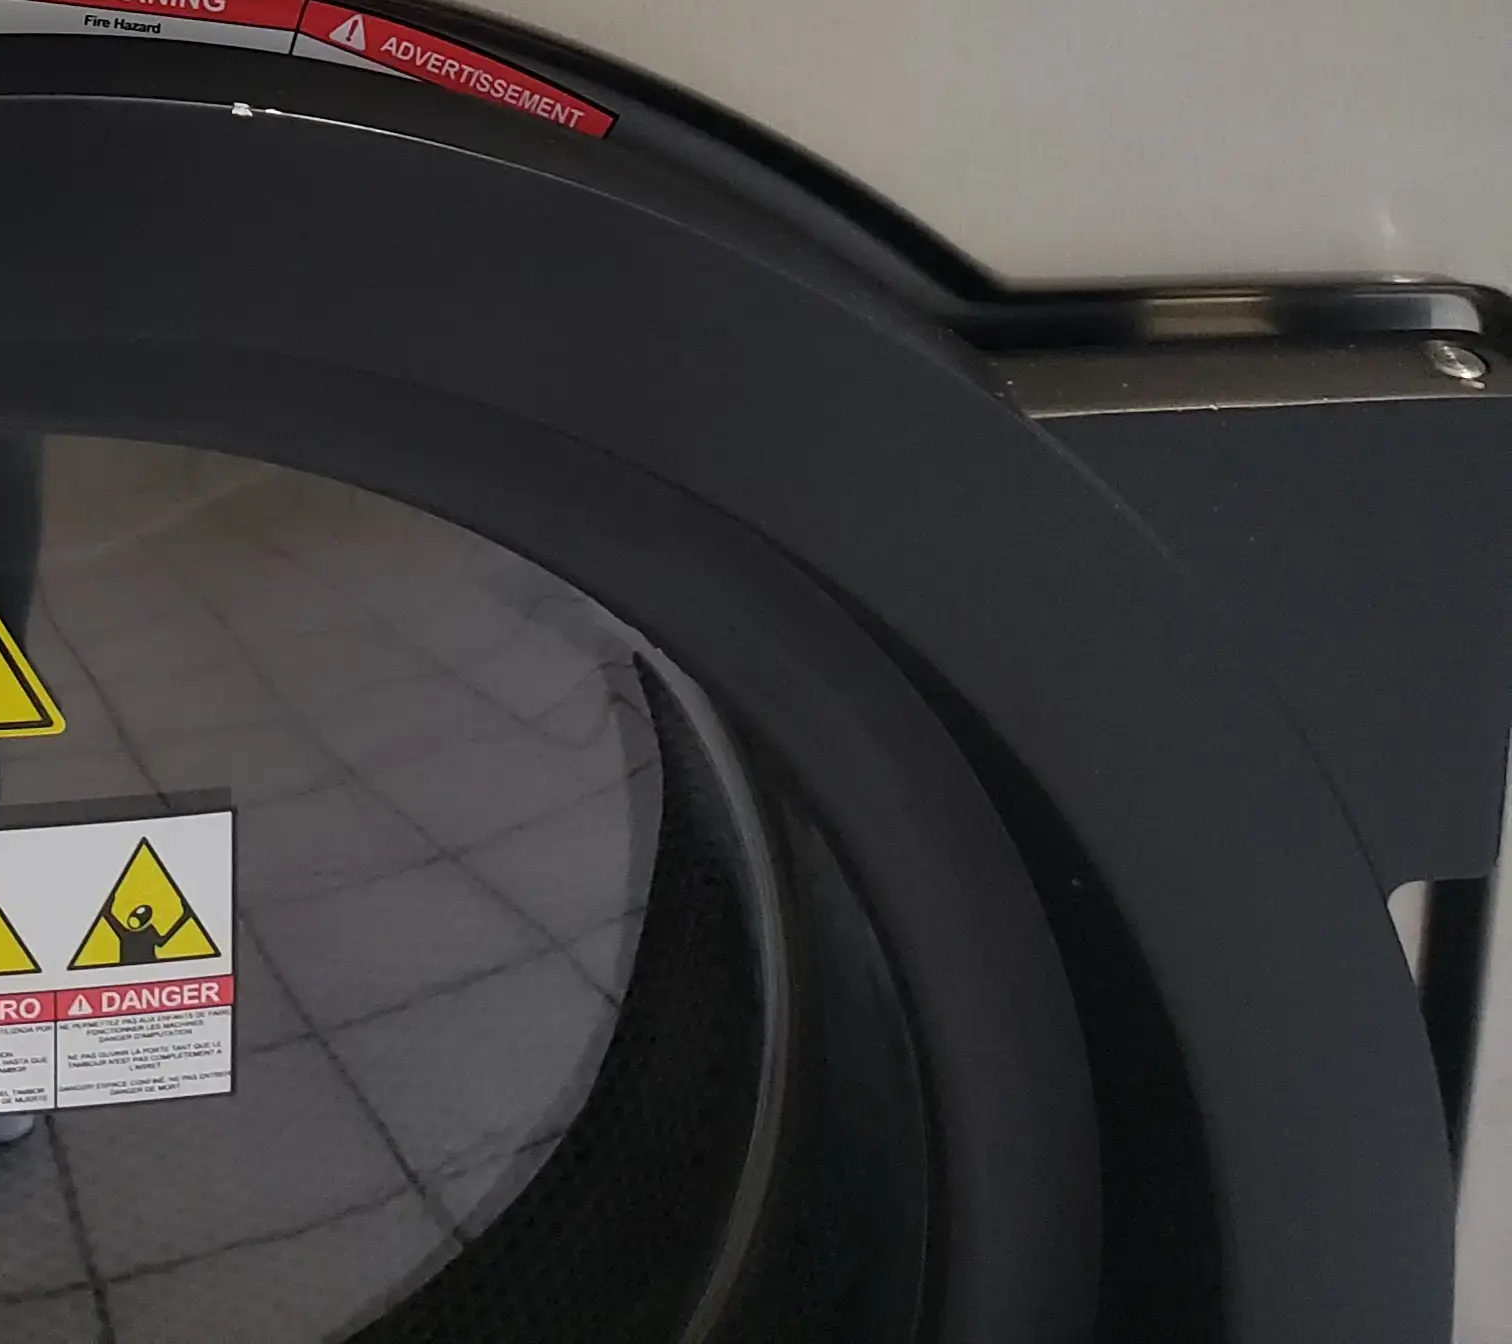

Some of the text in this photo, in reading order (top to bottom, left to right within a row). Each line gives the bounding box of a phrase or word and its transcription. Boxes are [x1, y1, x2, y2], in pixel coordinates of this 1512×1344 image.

[83, 14, 162, 35] Fire Hazard
[379, 36, 585, 129] ADVERTISSEMENT
[101, 982, 221, 1013] DANGER
